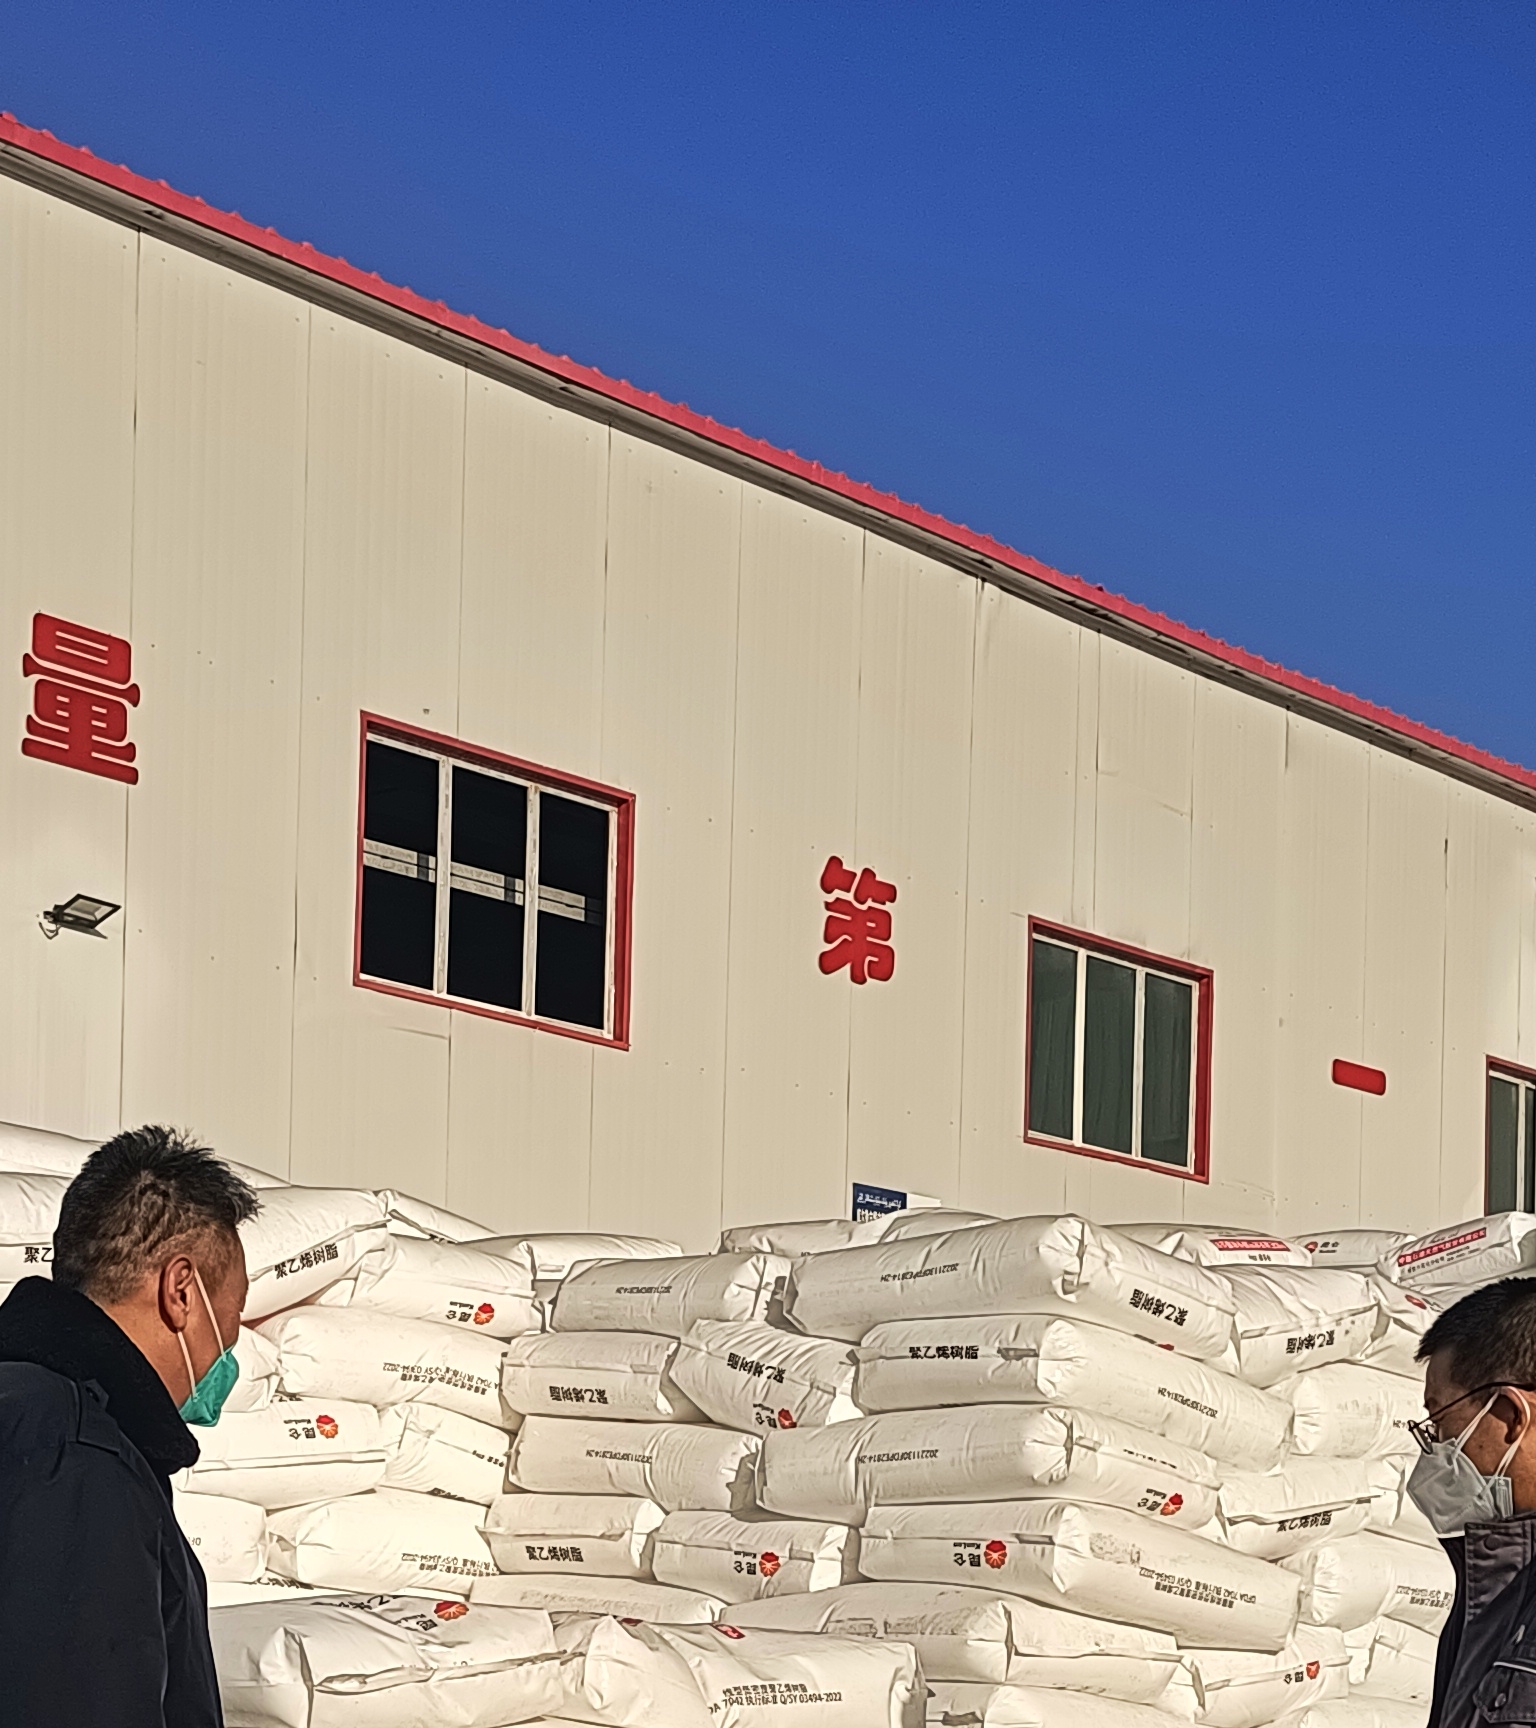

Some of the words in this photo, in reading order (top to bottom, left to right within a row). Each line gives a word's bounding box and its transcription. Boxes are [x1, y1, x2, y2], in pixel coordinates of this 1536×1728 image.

[21, 612, 141, 785] 量
[818, 855, 897, 985] 第
[274, 1243, 339, 1280] 聚乙烯树脂
[1129, 1288, 1188, 1326] 聚乙烯树脂
[908, 1345, 979, 1360] 聚乙烯树脂
[727, 1352, 785, 1383] 聚乙烯树脂
[549, 1386, 608, 1405] 聚乙烯树脂
[526, 1545, 584, 1563] 聚乙烯树脂
[953, 1553, 981, 1567] 昆仑
[722, 1697, 743, 1712] 7042
[744, 1695, 778, 1706] 执行标准
[780, 1694, 797, 1705] Q/SY
[799, 1692, 842, 1703] 03494-2022
